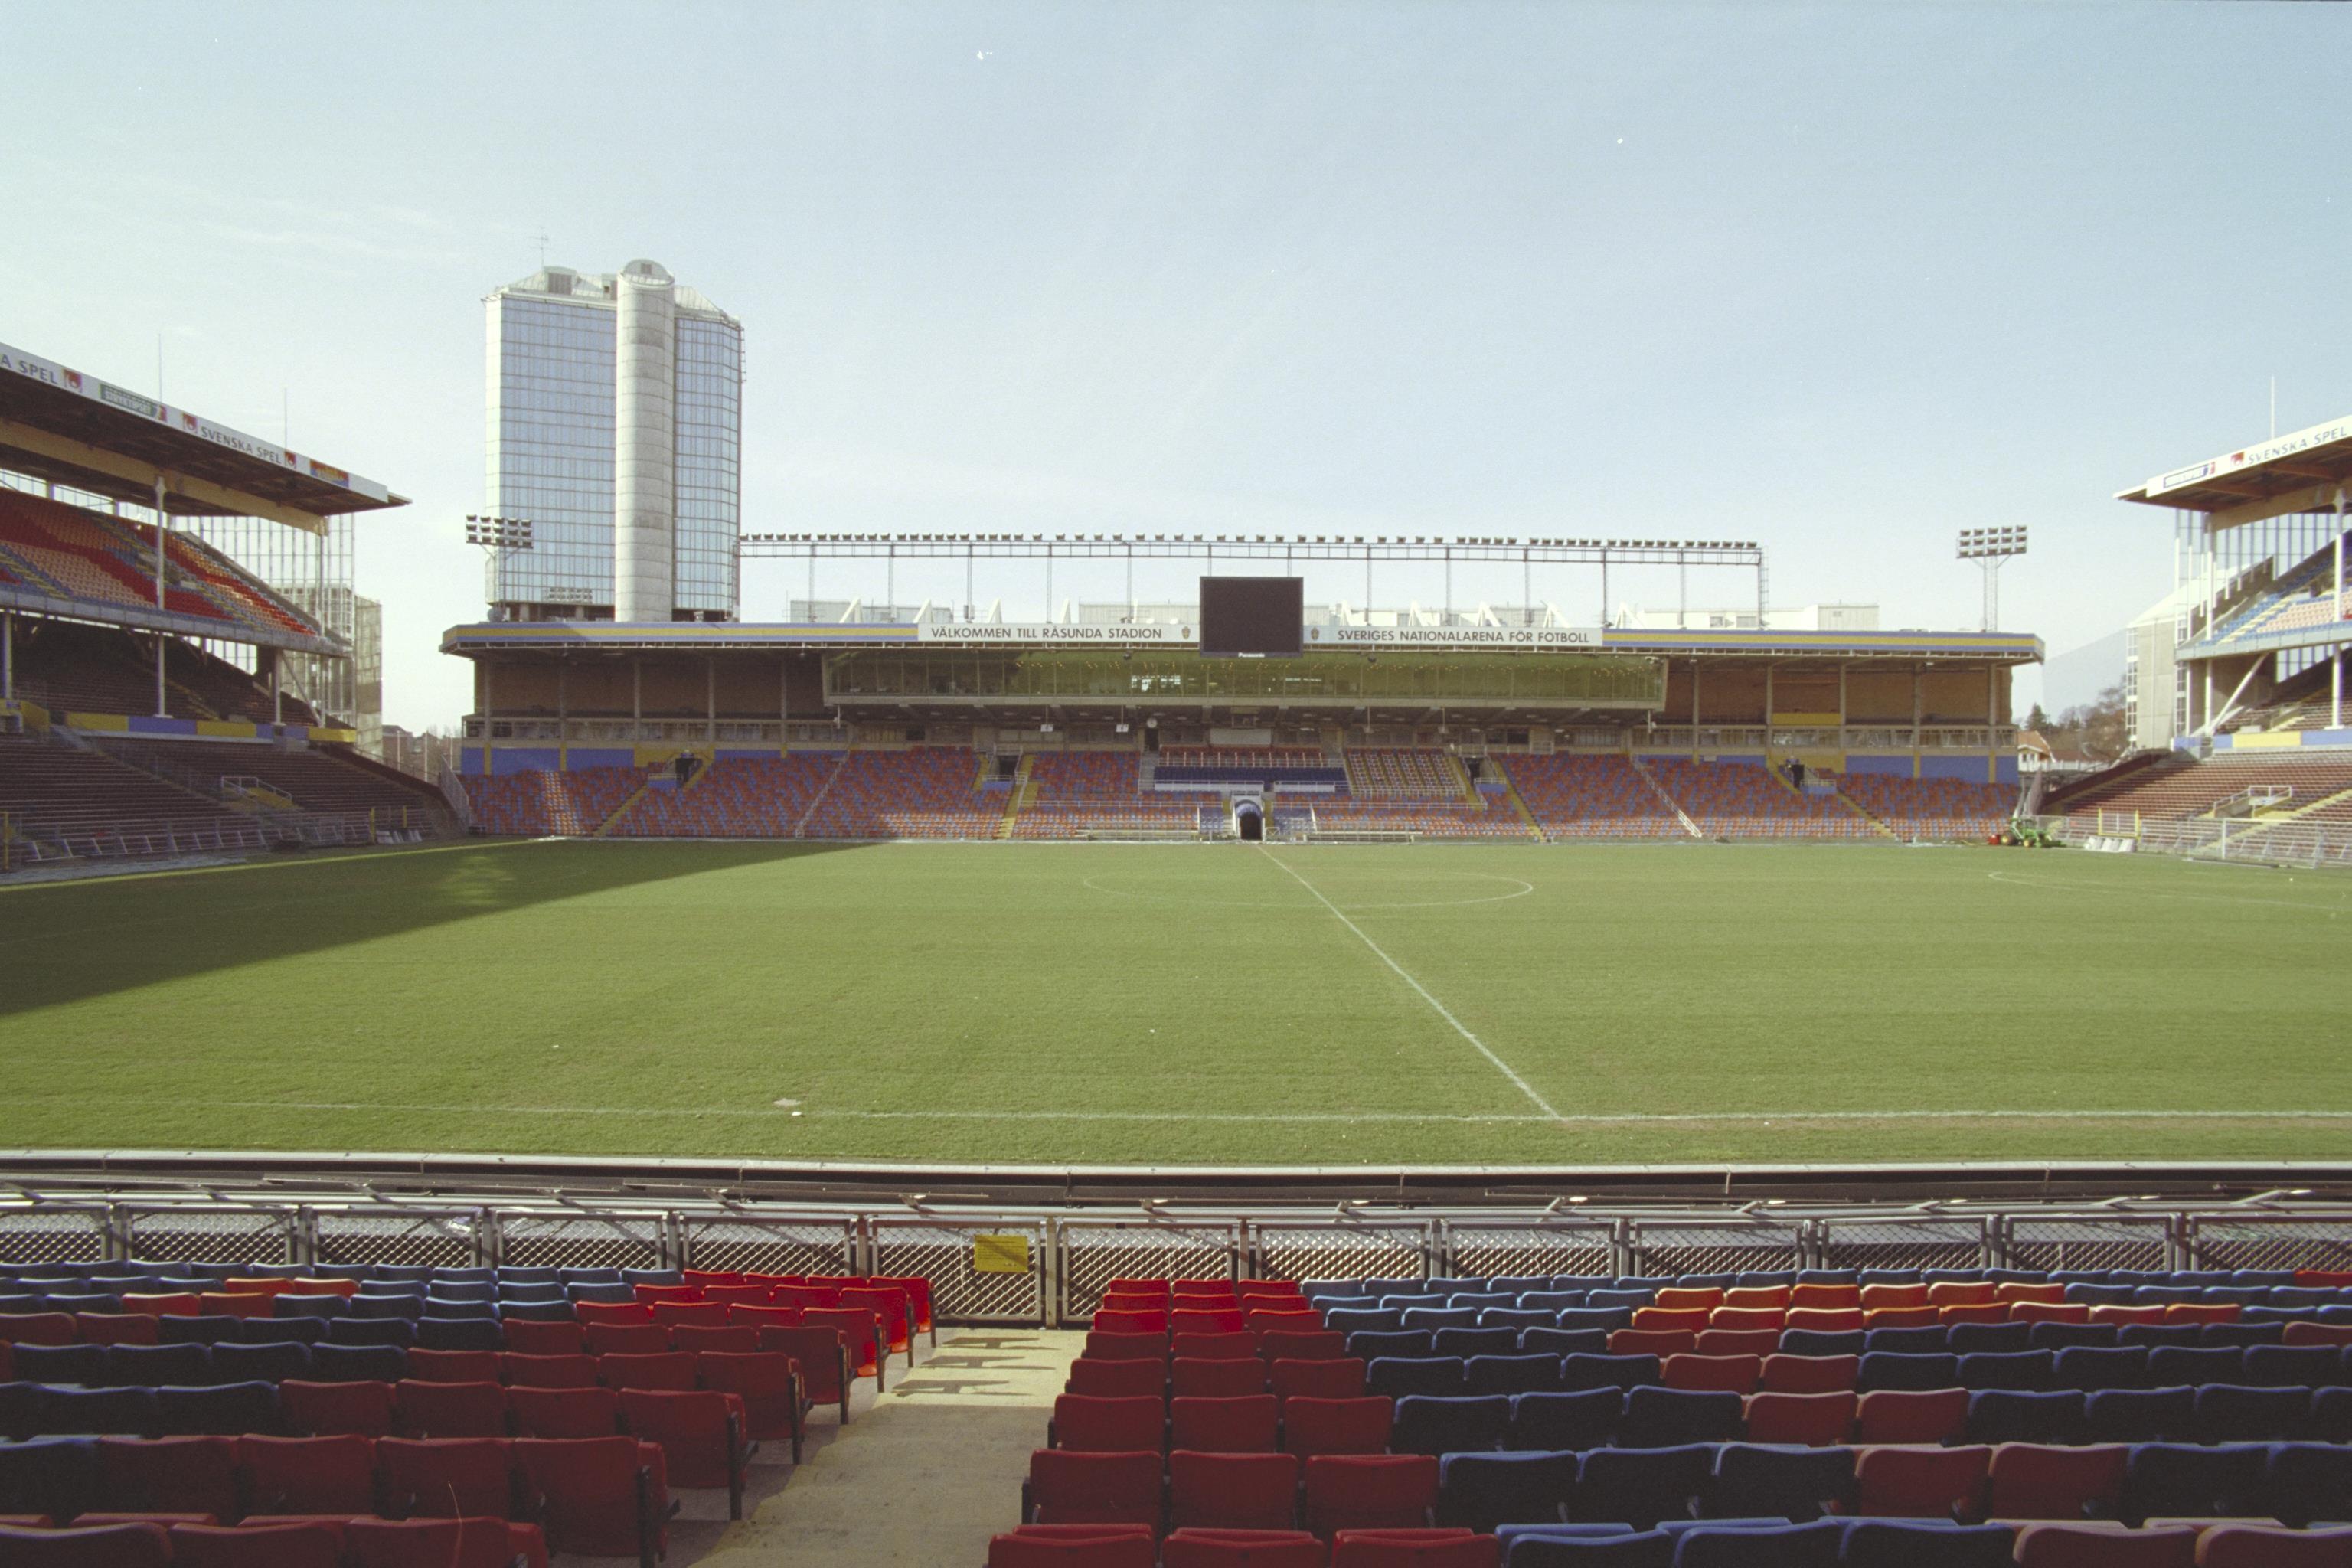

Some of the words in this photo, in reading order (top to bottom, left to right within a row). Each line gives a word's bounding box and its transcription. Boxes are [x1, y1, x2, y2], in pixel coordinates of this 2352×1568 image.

[19, 360, 58, 384] SPEL
[201, 426, 253, 454] SVENSKA
[257, 446, 282, 464] SPEL
[2248, 438, 2308, 465] SVENSKA
[2314, 426, 2347, 445] SPEL
[931, 626, 1011, 638] VÄLKOMMEN
[1017, 628, 1037, 638] TILL
[1042, 627, 1102, 639] RÅSUNDA
[1108, 628, 1162, 639] STADION
[1338, 630, 1394, 641] SVERIGES
[1400, 630, 1504, 642] NATIONALARENA
[1509, 631, 1533, 642] FÖR
[1538, 632, 1589, 642] FOTBOLL
